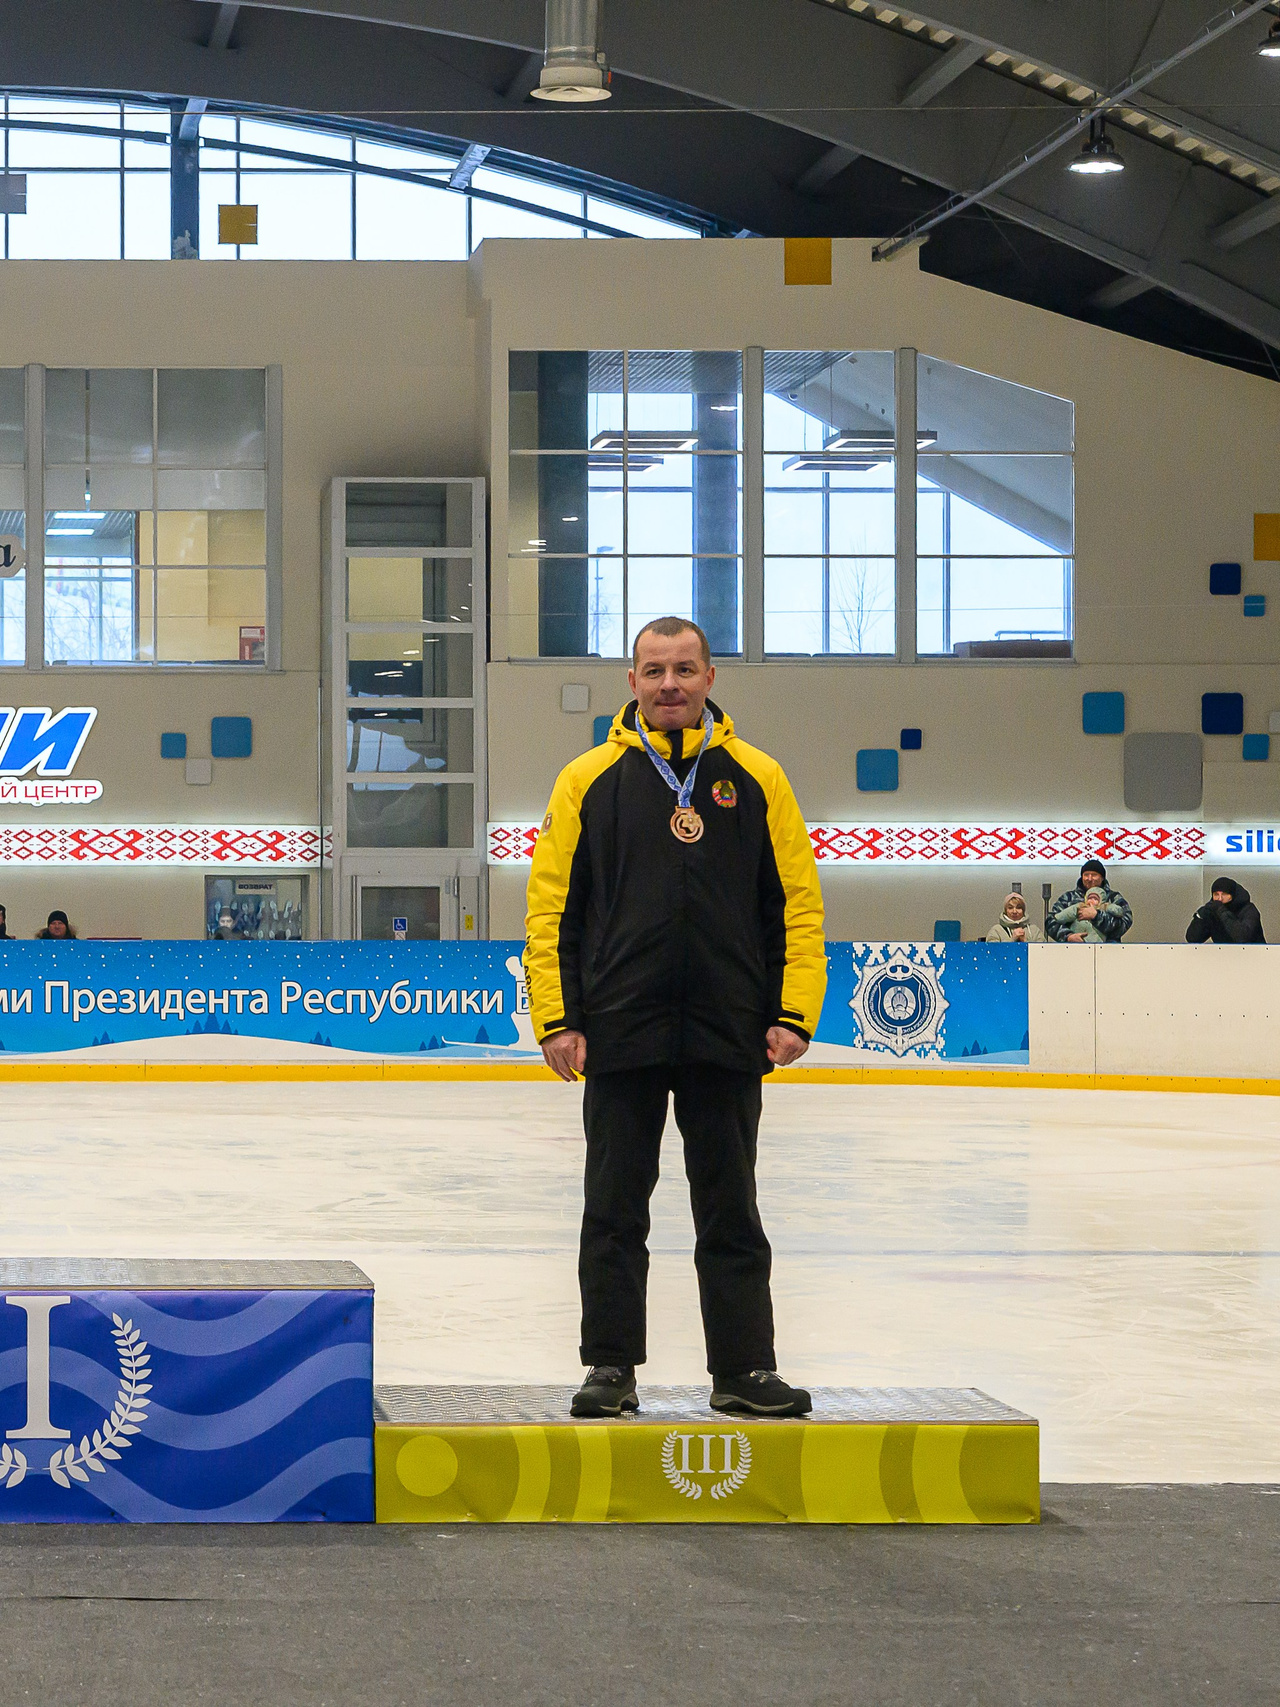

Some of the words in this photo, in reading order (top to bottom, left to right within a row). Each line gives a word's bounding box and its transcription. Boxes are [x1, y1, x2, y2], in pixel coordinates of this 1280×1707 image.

[24, 786, 98, 801] ЦЕНТР
[1226, 830, 1280, 853] sili
[44, 980, 269, 1021] Президента
[280, 979, 503, 1023] Республики
[6, 1295, 71, 1439] I
[676, 1434, 737, 1474] III
